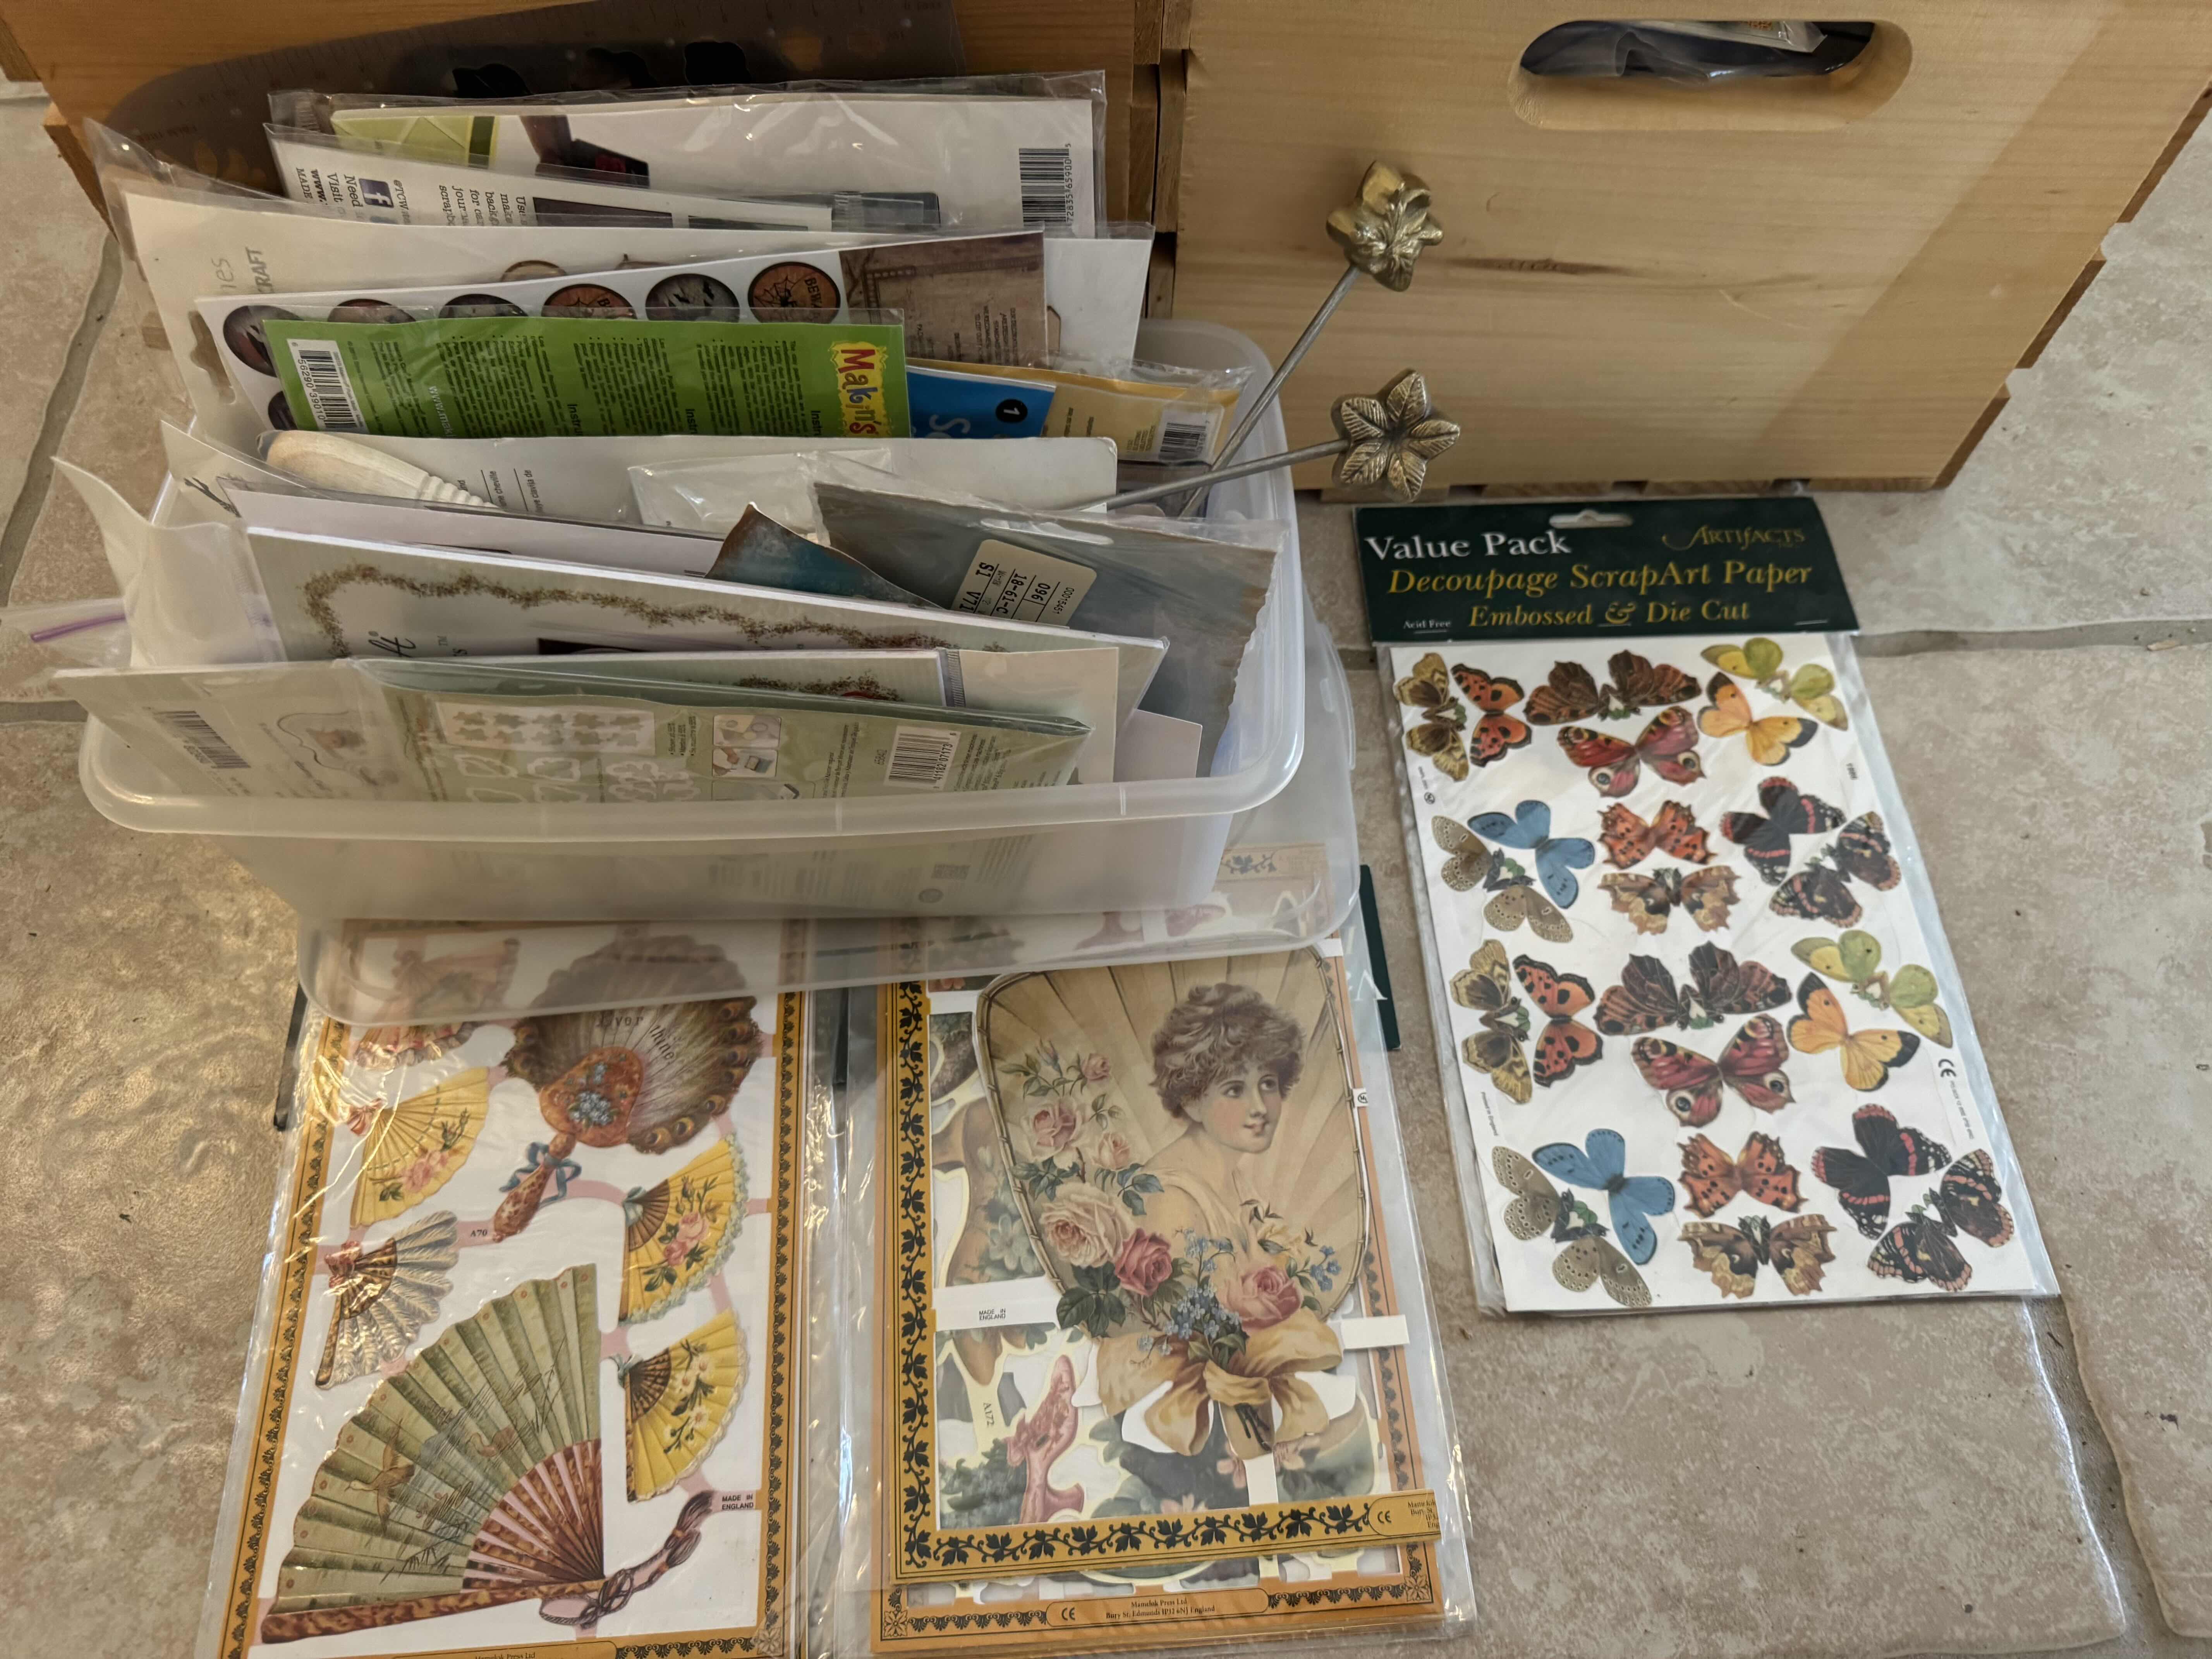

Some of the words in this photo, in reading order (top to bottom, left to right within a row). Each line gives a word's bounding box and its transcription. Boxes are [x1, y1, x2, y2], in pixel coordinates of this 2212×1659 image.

[296, 167, 311, 198] MADE
[326, 172, 343, 203] Visit
[344, 175, 364, 208] Need
[469, 189, 481, 206] for
[297, 359, 315, 388] 56290
[310, 392, 326, 421] 39010
[1004, 407, 1020, 415] 1
[489, 471, 503, 495] cheville
[1365, 536, 1470, 560] Value
[1484, 530, 1572, 557] Pack
[1387, 568, 1558, 598] Decoupage
[1570, 563, 1711, 592] ScrapArt
[1723, 560, 1813, 592] Paper
[996, 572, 1027, 615] 18-61-C
[1030, 583, 1051, 602] 096
[1053, 587, 1075, 615] 00015451
[1403, 620, 1425, 629] Acid
[1428, 619, 1451, 629] Free
[1469, 604, 1593, 628] Embossed
[1604, 603, 1636, 624] &
[1647, 601, 1691, 623] Die
[1701, 599, 1750, 621] Cut
[939, 744, 953, 762] 07173
[471, 1230, 488, 1238] A70
[983, 1402, 995, 1427] A172
[722, 1502, 754, 1510] ENGLAND
[1132, 1607, 1160, 1617] Edmunds
[1190, 1604, 1215, 1614] England
[1176, 1597, 1187, 1605] Ltd
[525, 1651, 536, 1659] Ltd
